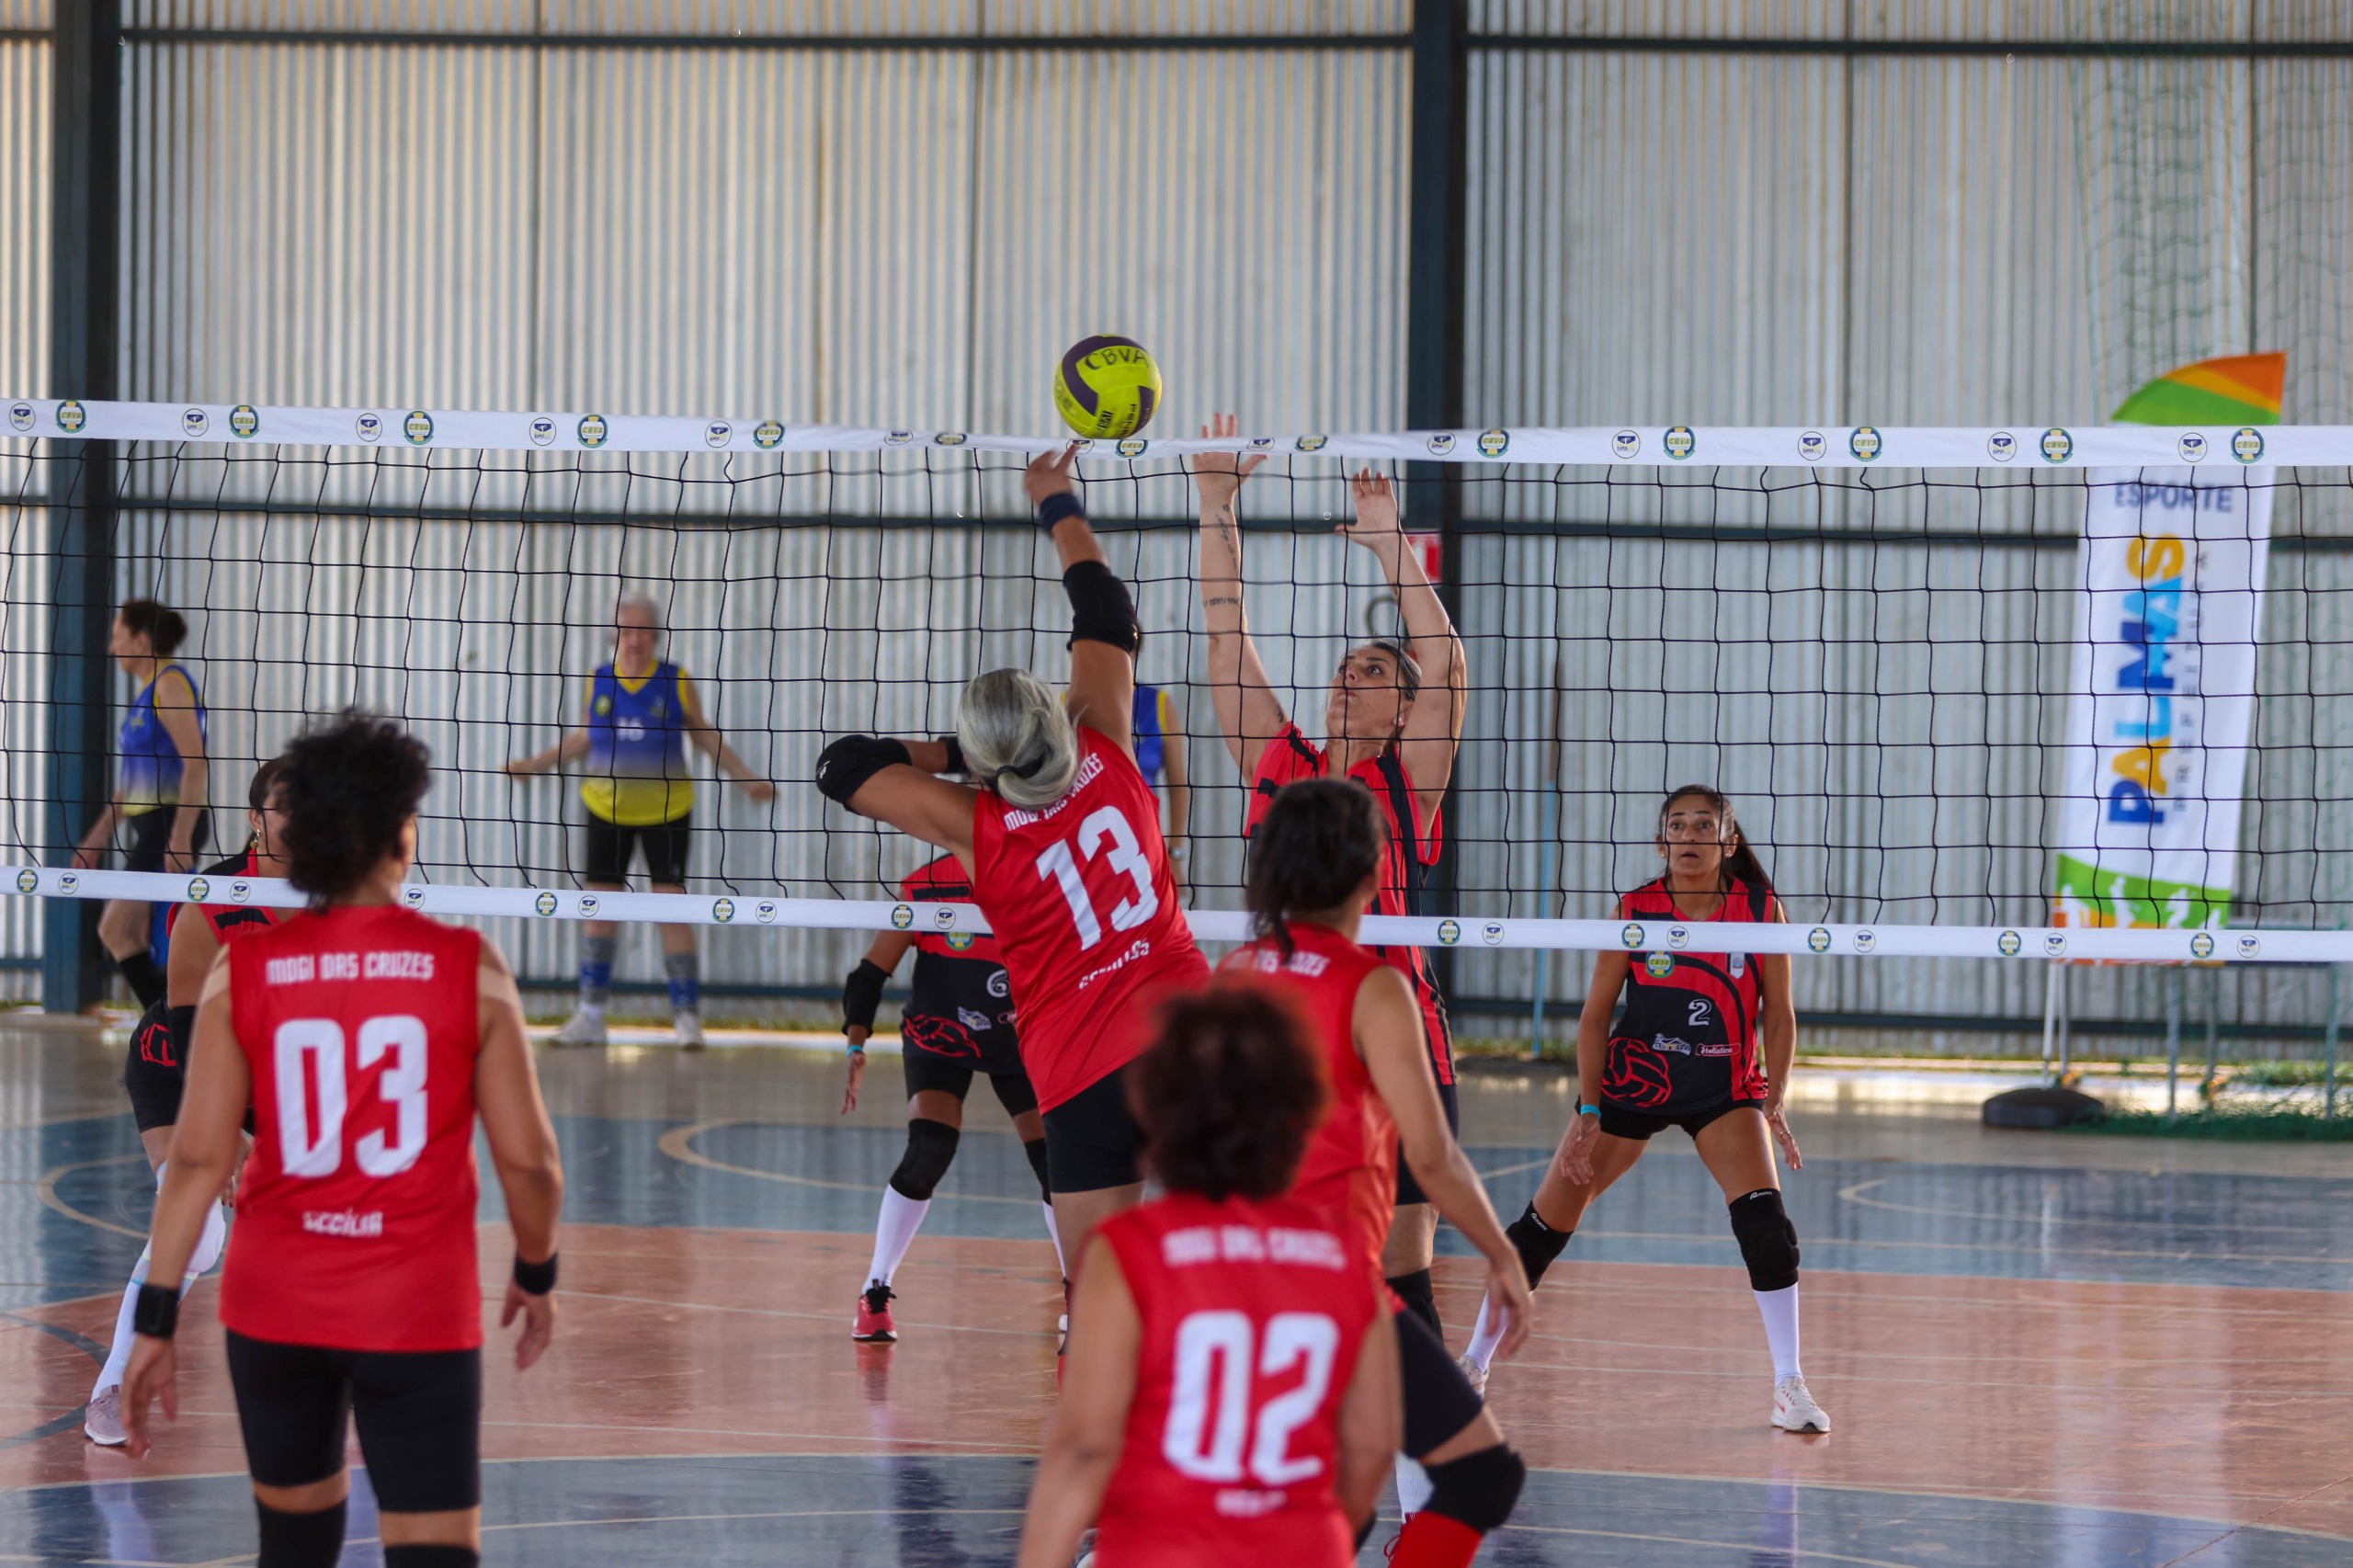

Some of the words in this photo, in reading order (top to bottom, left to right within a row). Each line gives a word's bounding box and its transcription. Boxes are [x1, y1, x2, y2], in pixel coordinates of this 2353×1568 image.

[1086, 347, 1149, 369] CBVA
[408, 423, 429, 431] CBVA
[2115, 481, 2234, 512] ESPORTE
[2108, 533, 2186, 825] PALMAS
[1005, 809, 1042, 832] MOG
[1036, 805, 1159, 951] 13
[267, 954, 315, 985] MOGI
[320, 952, 360, 981] DAS
[364, 950, 435, 982] CRUZES
[986, 970, 1010, 998] 6
[1688, 999, 1712, 1027] 2
[274, 1015, 429, 1177] 03
[1162, 1310, 1341, 1486] 02
